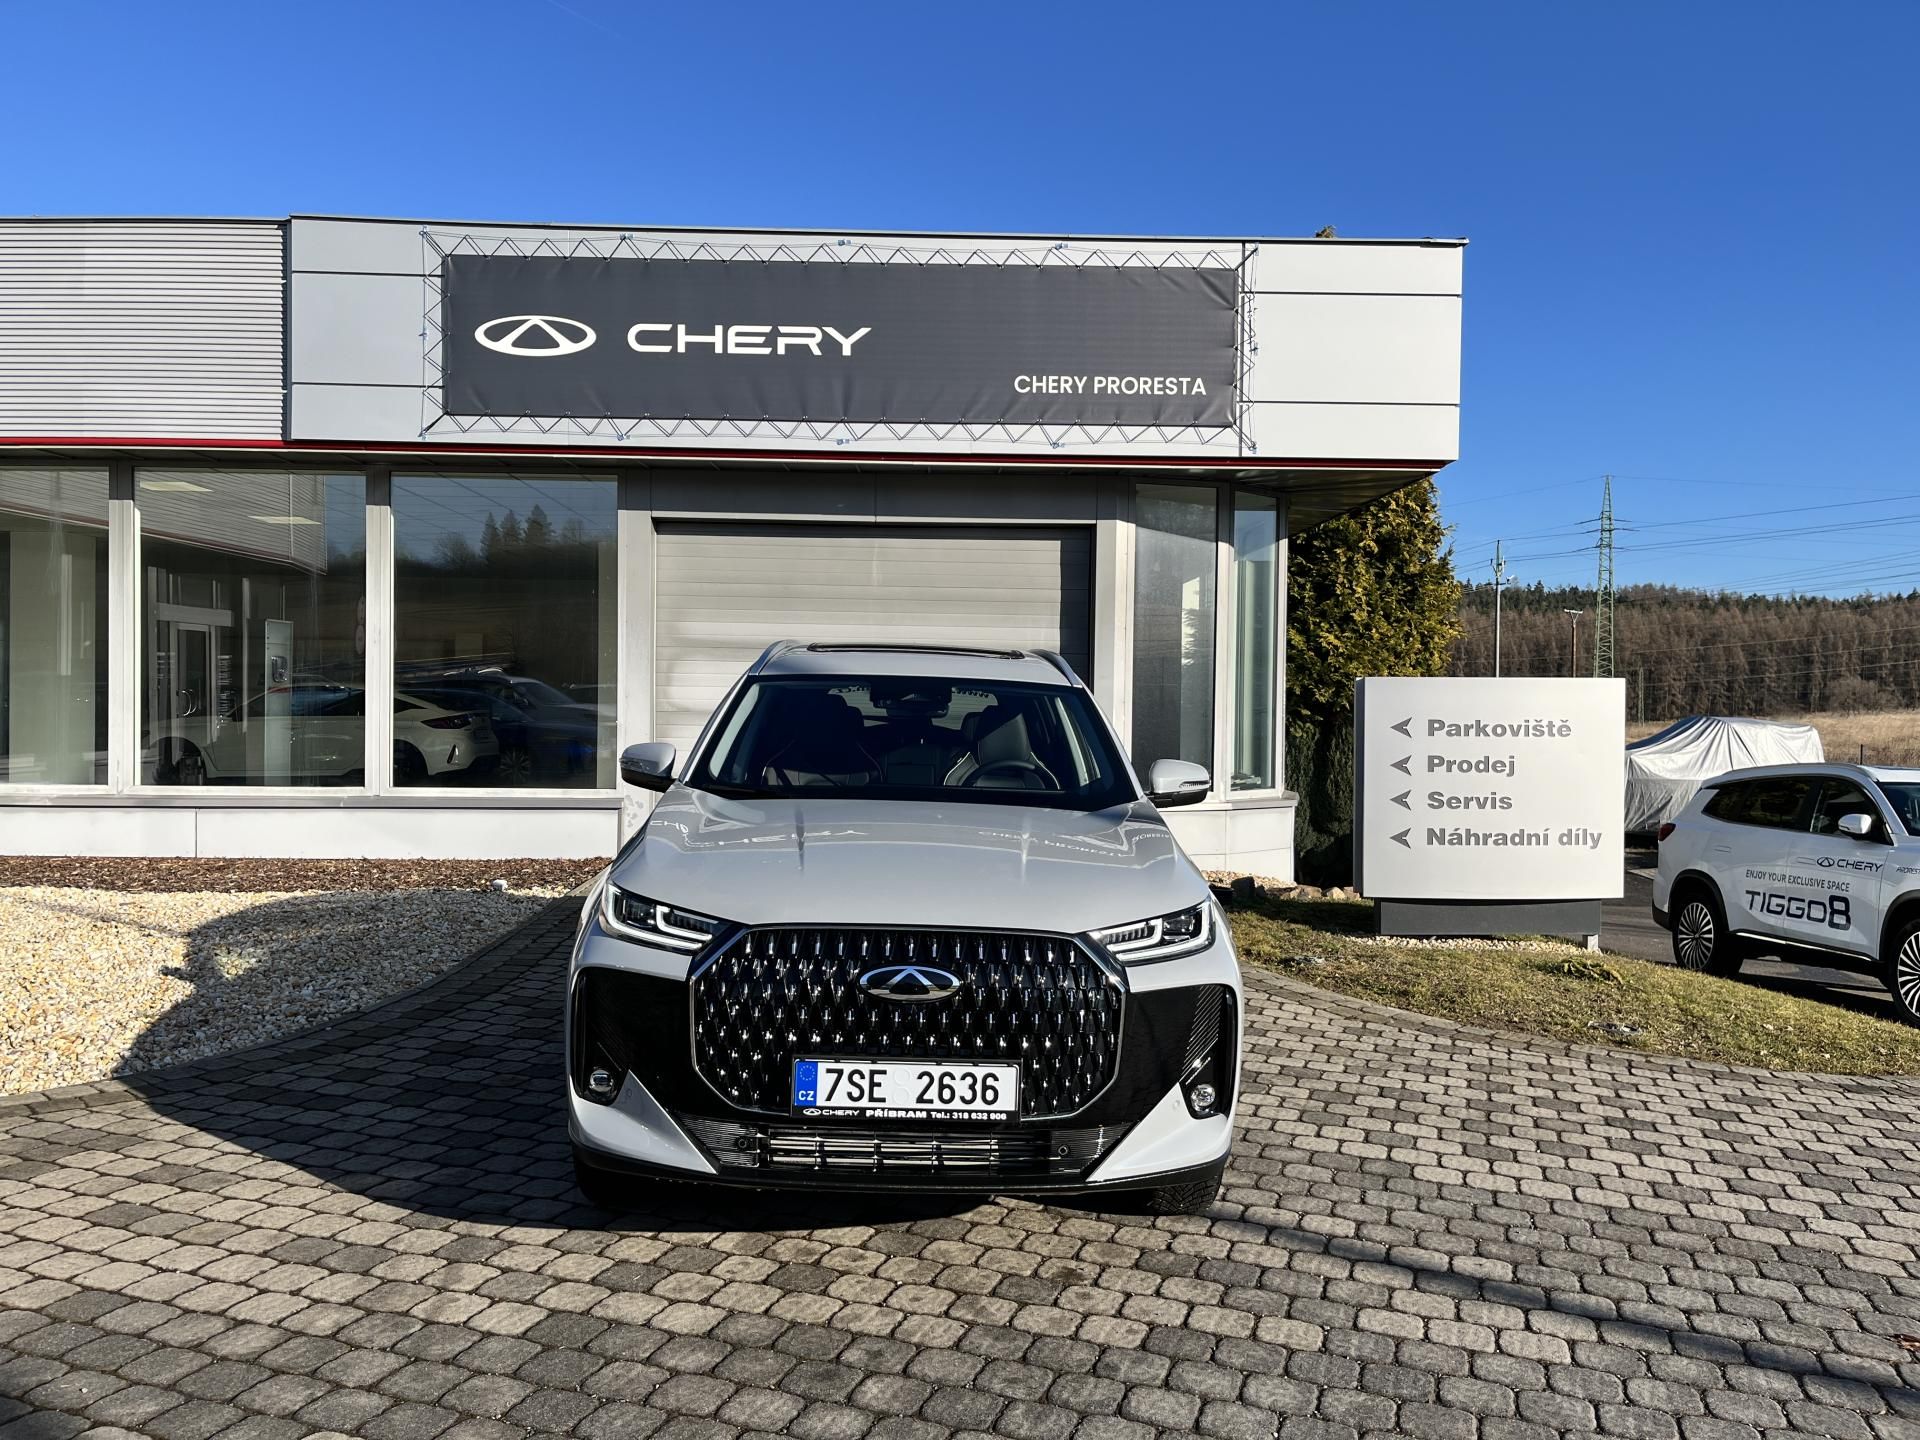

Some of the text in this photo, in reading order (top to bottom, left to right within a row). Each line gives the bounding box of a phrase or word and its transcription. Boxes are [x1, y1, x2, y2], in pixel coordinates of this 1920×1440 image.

[627, 323, 872, 356] CHERY
[1014, 375, 1207, 396] CHERY PRORESTA
[1427, 719, 1572, 738] Parkoviště
[1427, 755, 1515, 777] Prodej
[1427, 791, 1513, 810] Servis
[1426, 827, 1602, 850] Náhradní díly
[1836, 858, 1884, 873] CHERY
[1745, 869, 1851, 893] ENJOY YOUR EXCLUSIVE SPACE
[798, 1068, 1000, 1106] CZ 7SE 2636
[822, 1109, 860, 1117] CHERY
[865, 1108, 927, 1119] PŘÍBRAM
